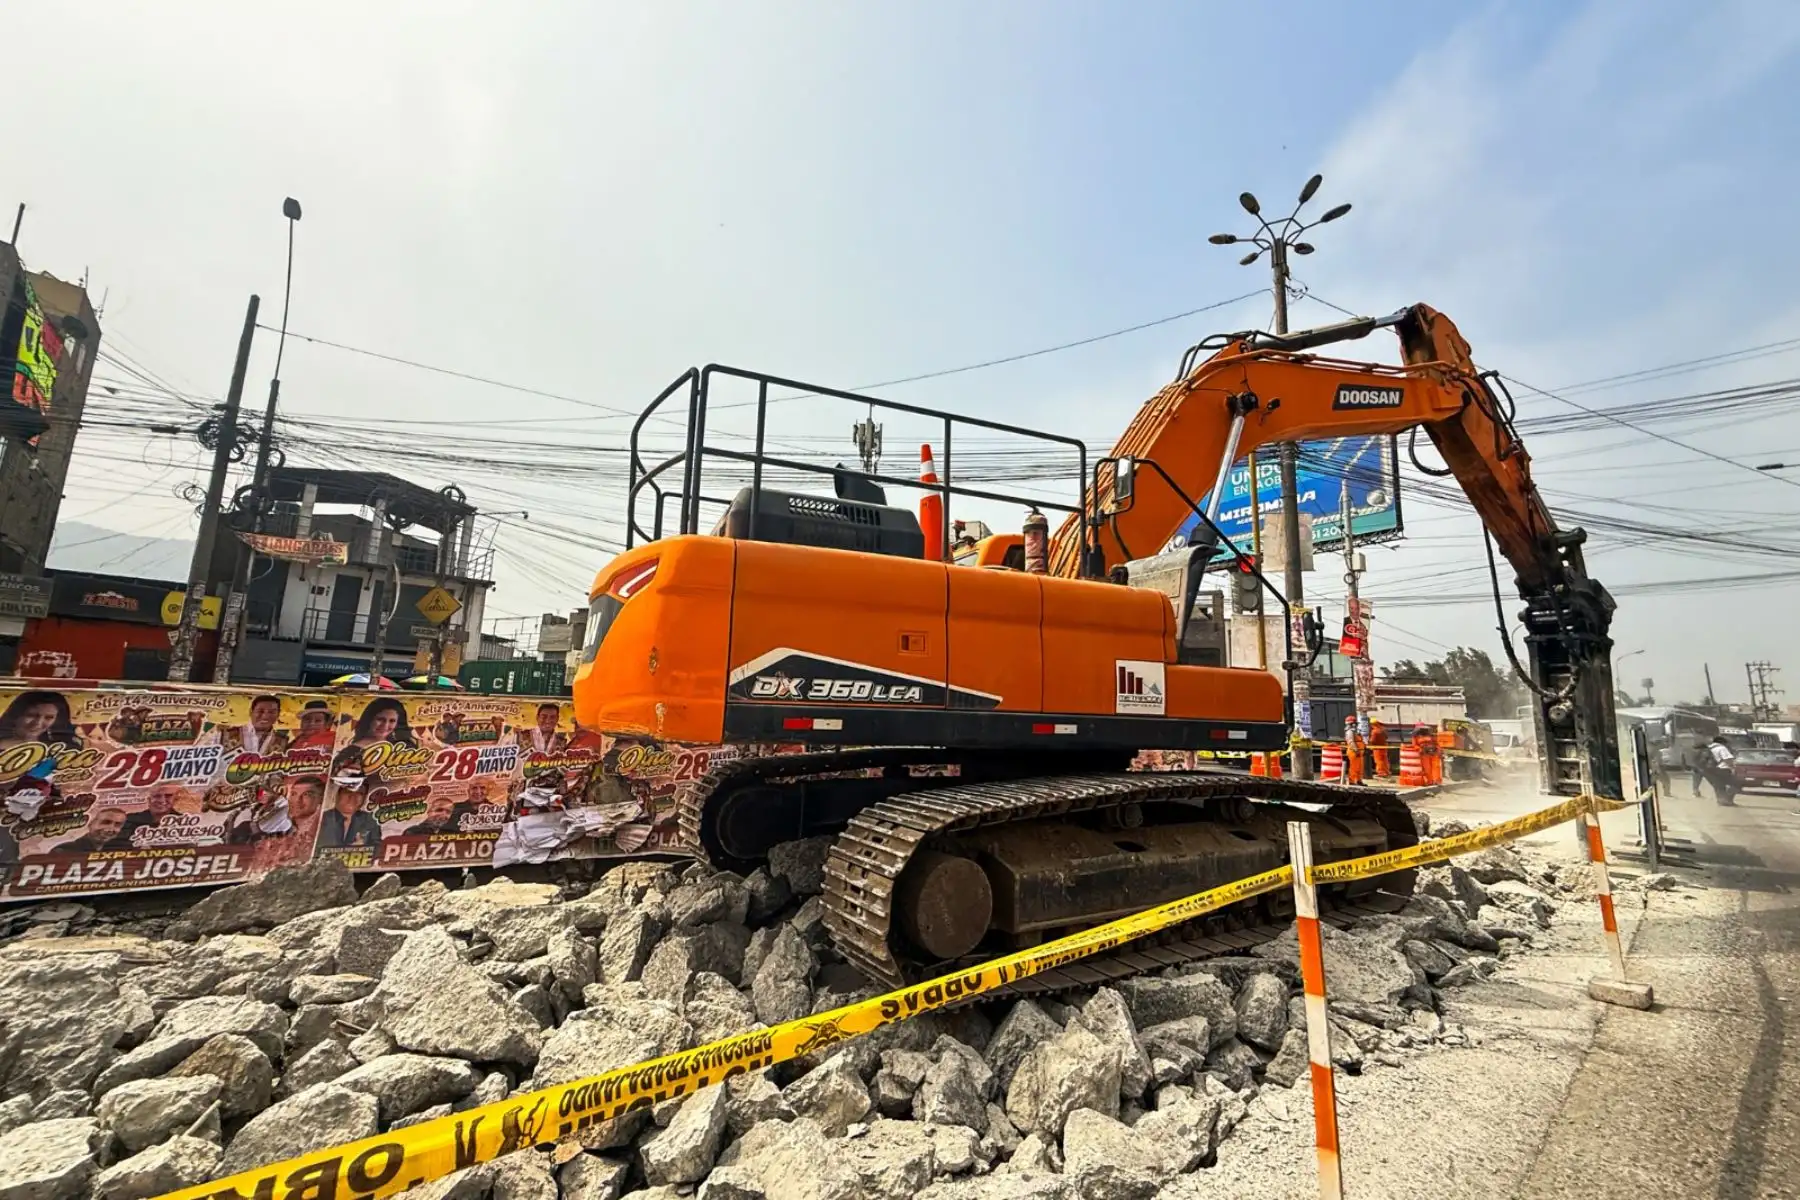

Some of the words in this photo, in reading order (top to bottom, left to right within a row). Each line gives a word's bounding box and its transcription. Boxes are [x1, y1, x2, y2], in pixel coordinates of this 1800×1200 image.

[1340, 390, 1400, 404] DOOSAN
[752, 676, 800, 698] DX
[85, 698, 119, 711] Feliz
[150, 693, 225, 708] Aniversario
[418, 705, 442, 714] Feliz
[465, 702, 519, 714] Aniversario
[142, 721, 192, 732] PLAZA
[460, 723, 496, 732] PLAZA
[167, 747, 220, 760] JUEVES
[362, 741, 434, 775] Dina
[480, 746, 518, 758] JUEVES
[618, 747, 675, 775] Dina
[710, 750, 737, 760] JUEVES
[95, 749, 167, 789] 28
[162, 760, 217, 779] MAYO
[431, 749, 480, 780] 28
[477, 757, 516, 774] MAYO
[676, 752, 708, 781] 28
[134, 825, 223, 841] AYACUCHO
[88, 848, 196, 860] EXPLANADA
[384, 843, 457, 863] PLAZA
[18, 860, 124, 887] PLAZA
[134, 854, 243, 879] JOSFEL
[35, 883, 106, 894] CARRETERA
[109, 878, 158, 888] CENTRAL
[690, 1033, 774, 1070] PERSONAS
[558, 1055, 690, 1118] TRABAJANDO
